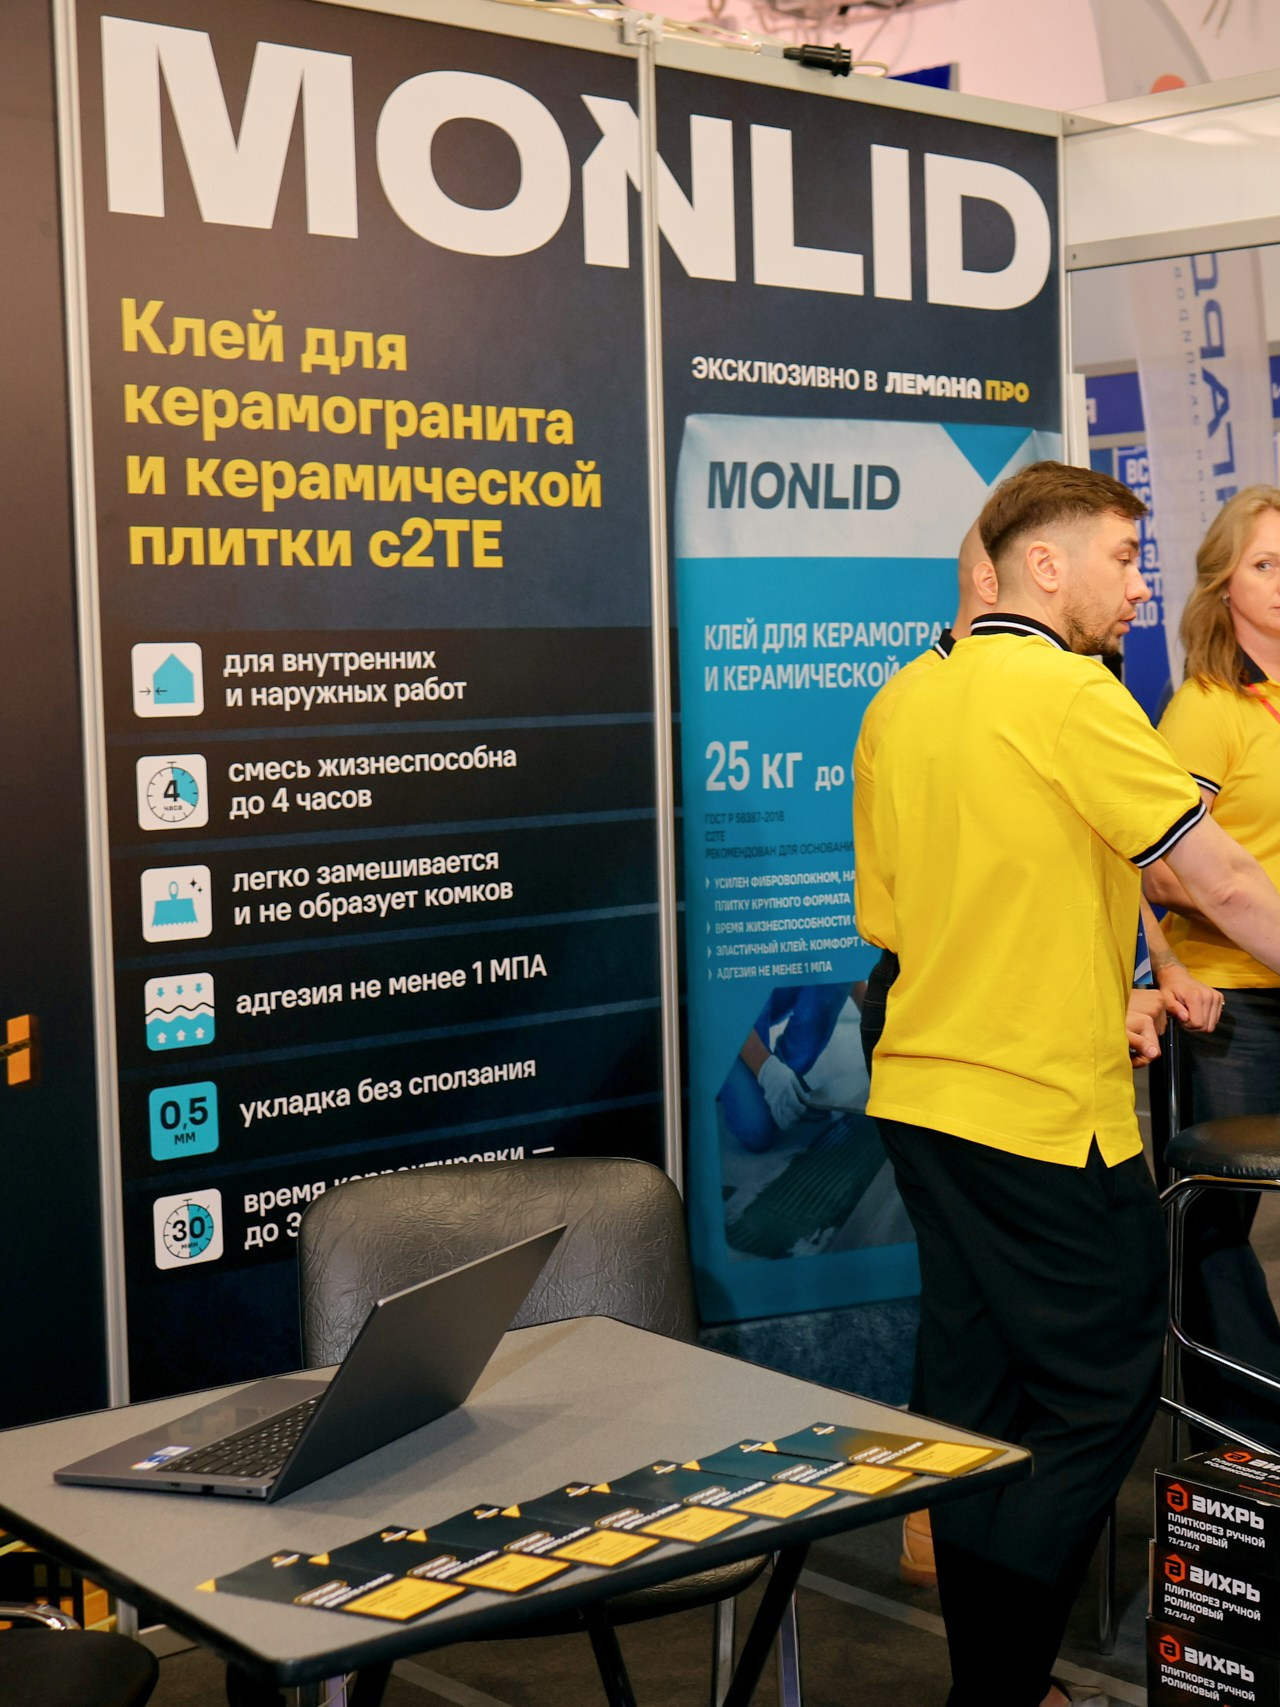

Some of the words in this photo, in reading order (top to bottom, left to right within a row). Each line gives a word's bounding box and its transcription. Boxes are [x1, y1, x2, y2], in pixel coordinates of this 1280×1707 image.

[101, 15, 1051, 310] MONLID
[121, 297, 284, 362] Клей
[300, 326, 408, 375] для
[691, 356, 861, 390] ЭКСКЛЮЗИВНО
[864, 372, 878, 391] В
[885, 371, 982, 400] ЛЕМАНА
[985, 379, 1030, 403] ПРО
[124, 382, 573, 450] керамогранита
[126, 454, 166, 495] и
[186, 460, 602, 512] керамической
[707, 461, 901, 510] MONLID
[129, 525, 351, 566] плитки
[705, 618, 757, 650] КЛЕЙ
[762, 623, 807, 654] ДЛЯ
[813, 621, 950, 648] КЕРАМОГРА
[223, 650, 274, 678] для
[282, 647, 436, 678] внутренних
[705, 666, 718, 692] И
[724, 655, 900, 691] КЕРАМИЧЕСКОЙ
[225, 686, 244, 707] и
[250, 681, 388, 714] наружных
[394, 677, 467, 708] работ
[227, 753, 310, 784] смесь
[318, 745, 517, 778] жизнеспособна
[705, 740, 751, 791] 25
[815, 765, 845, 791] до
[163, 780, 180, 802] 4
[229, 793, 266, 820] до
[272, 788, 290, 813] 4
[296, 786, 372, 811] часов
[705, 846, 776, 859] РЕКОМЕНДОВАН
[778, 844, 798, 857] ДЛЯ
[800, 841, 854, 855] ОСНОВАНИ
[232, 863, 310, 896] легко
[317, 851, 499, 886] замешивается
[714, 877, 749, 889] УСИЛЕН
[751, 871, 841, 888] ФИБРОВОЛОКНОМ,
[234, 903, 251, 926] и
[259, 898, 292, 924] не
[299, 885, 418, 923] образует
[425, 880, 513, 907] комков
[715, 899, 750, 911] ПЛИТКУ
[752, 897, 800, 910] КРУПНОГО
[803, 893, 850, 906] ФОРМАТА
[715, 922, 744, 934] ВРЕМЯ
[746, 915, 850, 932] ЖИЗНЕСПОСОБНОСТИ
[717, 940, 778, 956] ЭЛАСТИЧНЫЙ
[781, 938, 808, 952] КЛЕЙ:
[810, 936, 858, 950] КОМФОРТ
[235, 981, 343, 1018] адгезия
[350, 976, 382, 1000] не
[388, 968, 466, 997] менее
[472, 960, 485, 986] 1
[489, 954, 547, 983] МПА
[717, 966, 756, 980] АДГЕЗИЯ
[759, 965, 770, 976] НЕ
[772, 963, 802, 975] МЕНЕЕ
[811, 961, 832, 973] МПА
[239, 1084, 351, 1128] укладка
[357, 1074, 402, 1106] без
[409, 1058, 536, 1099] сползания
[160, 1096, 208, 1131] 0,5
[243, 1181, 326, 1217] время
[172, 1216, 206, 1242] 30
[244, 1223, 279, 1250] до
[286, 1212, 302, 1238] 3
[1168, 1512, 1224, 1536] ПЛИТКОРЕЗ
[1226, 1528, 1265, 1548] РУЧНОЙ
[1192, 1494, 1264, 1530] ВИХРЬ
[1168, 1524, 1228, 1549] РОЛИКОВЫЙ
[1190, 1565, 1260, 1602] ВИХРЬ
[1164, 1595, 1223, 1621] РОЛИКОВЫЙ
[1165, 1583, 1220, 1607] ПЛИТКОРЕЗ
[1222, 1600, 1261, 1621] РУЧНОЙ
[1184, 1646, 1254, 1682] ВИХРЬ
[1161, 1664, 1215, 1688] ПЛИТКОРЕЗ
[1217, 1682, 1255, 1701] РУЧНОЙ
[1161, 1675, 1219, 1701] РОЛИКОВЫЙ
